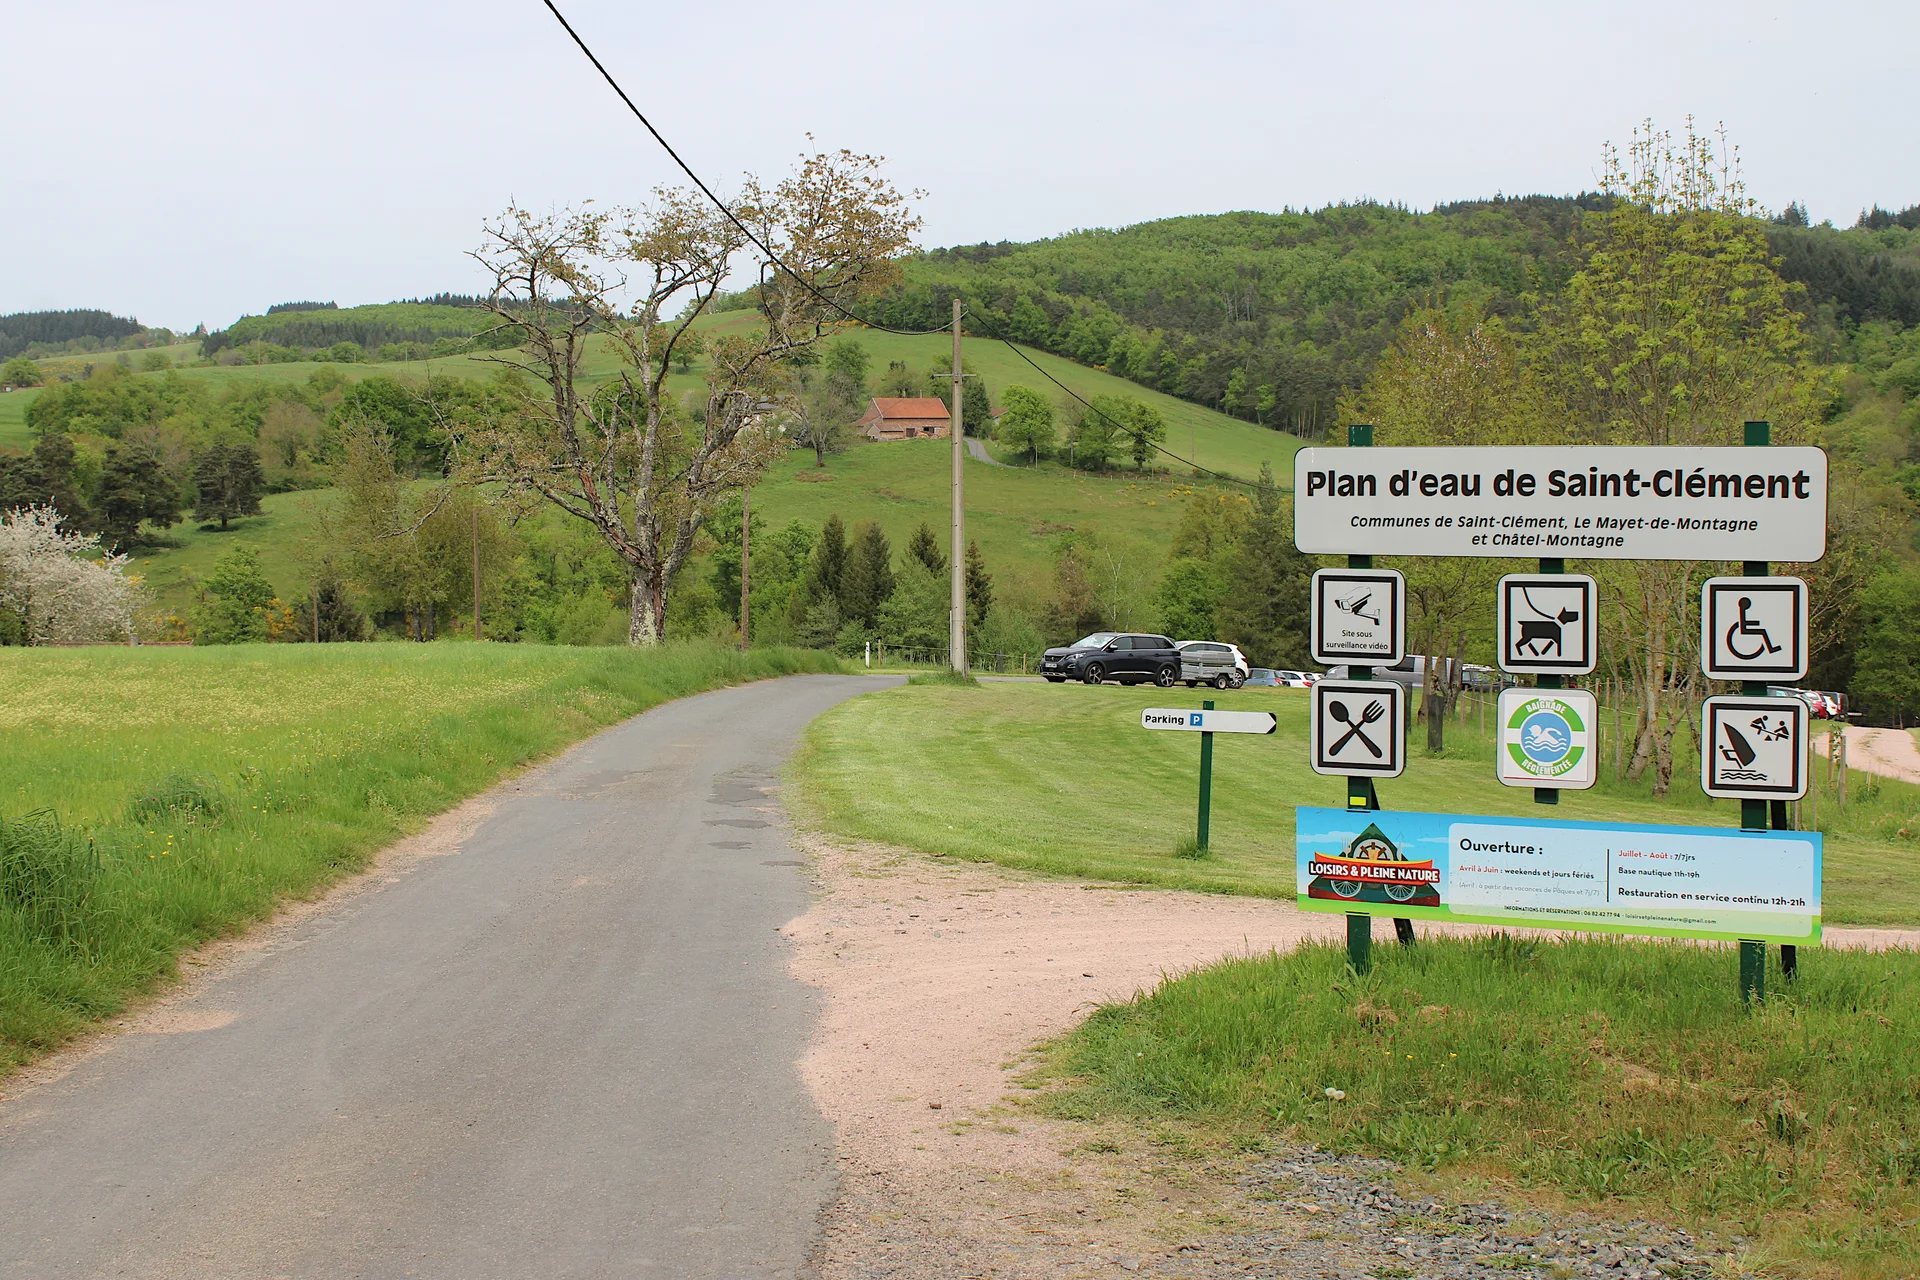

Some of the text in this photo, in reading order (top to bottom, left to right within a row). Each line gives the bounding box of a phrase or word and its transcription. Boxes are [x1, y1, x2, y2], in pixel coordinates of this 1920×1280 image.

[1307, 466, 1810, 499] Plan d'eau de Saint-Clément
[1350, 515, 1758, 532] Communes de Saint-Clément, Le Mayet-de-Montagne
[1471, 532, 1624, 548] et Châtel-Montagne
[1341, 629, 1356, 638] Site
[1326, 641, 1389, 650] surveillance vidéo
[1525, 699, 1567, 714] BAIGNADE
[1144, 714, 1201, 726] Parking P
[1521, 758, 1573, 776] RÉGLEMENTÉE
[1460, 838, 1535, 855] Ouverture
[1618, 850, 1642, 858] Juillet
[1674, 852, 1696, 862] 7/7jrs
[1309, 862, 1439, 882] LOISIRS & PLEINE NATURE
[1459, 864, 1476, 873] Avril
[1477, 865, 1482, 873] à
[1483, 865, 1499, 874] Juin
[1504, 867, 1541, 877] weekends
[1542, 869, 1551, 877] et
[1551, 869, 1571, 879] jours
[1572, 870, 1595, 880] fériés
[1618, 866, 1700, 879] Base nautique 11h-19h
[1484, 882, 1501, 892] partir
[1502, 883, 1514, 891] des
[1514, 885, 1542, 893] vacances
[1552, 886, 1576, 896] Pâques
[1618, 887, 1806, 907] Restauration en service continu 12h-21h
